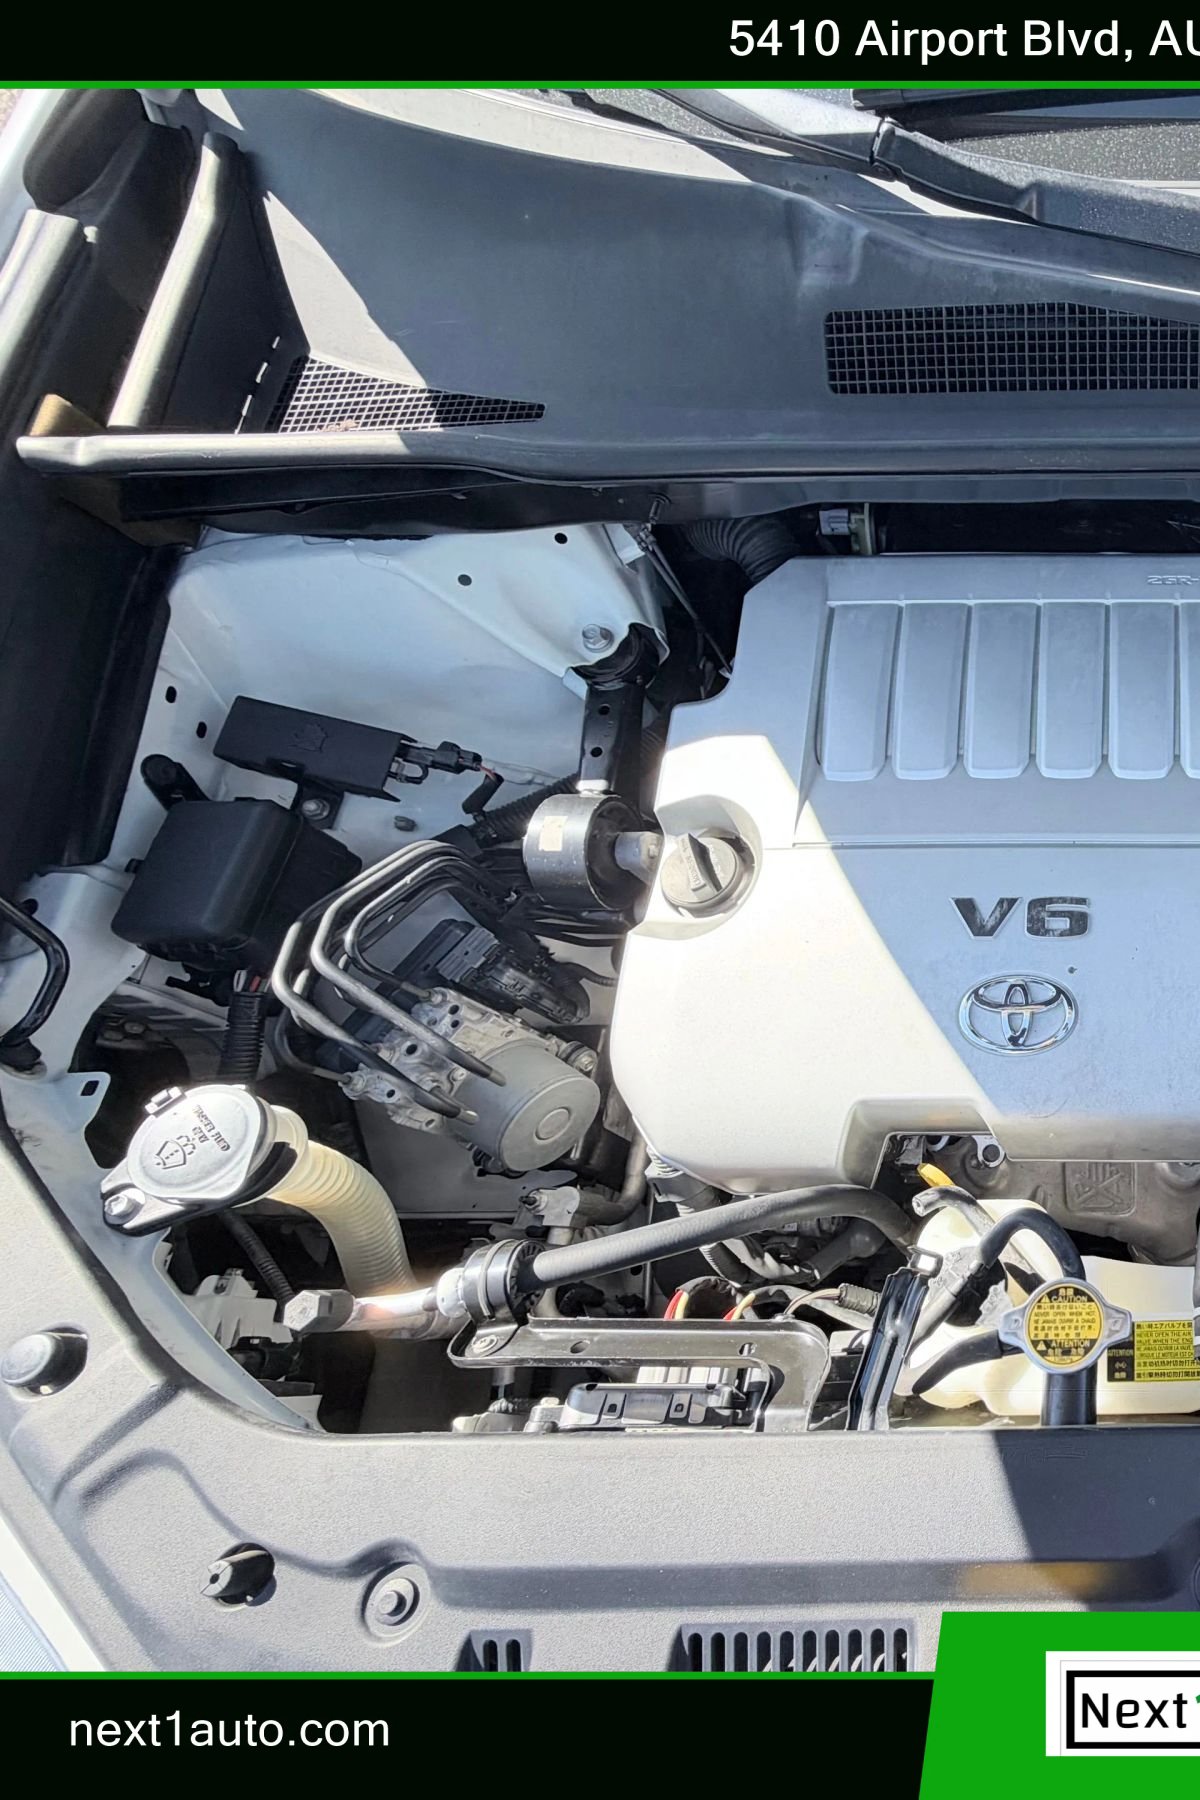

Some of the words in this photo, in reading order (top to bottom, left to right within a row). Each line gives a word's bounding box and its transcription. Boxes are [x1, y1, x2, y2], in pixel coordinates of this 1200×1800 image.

[949, 895, 1092, 941] V6
[1051, 1295, 1088, 1303] CAUTION
[1051, 1340, 1091, 1348] ATTENTION
